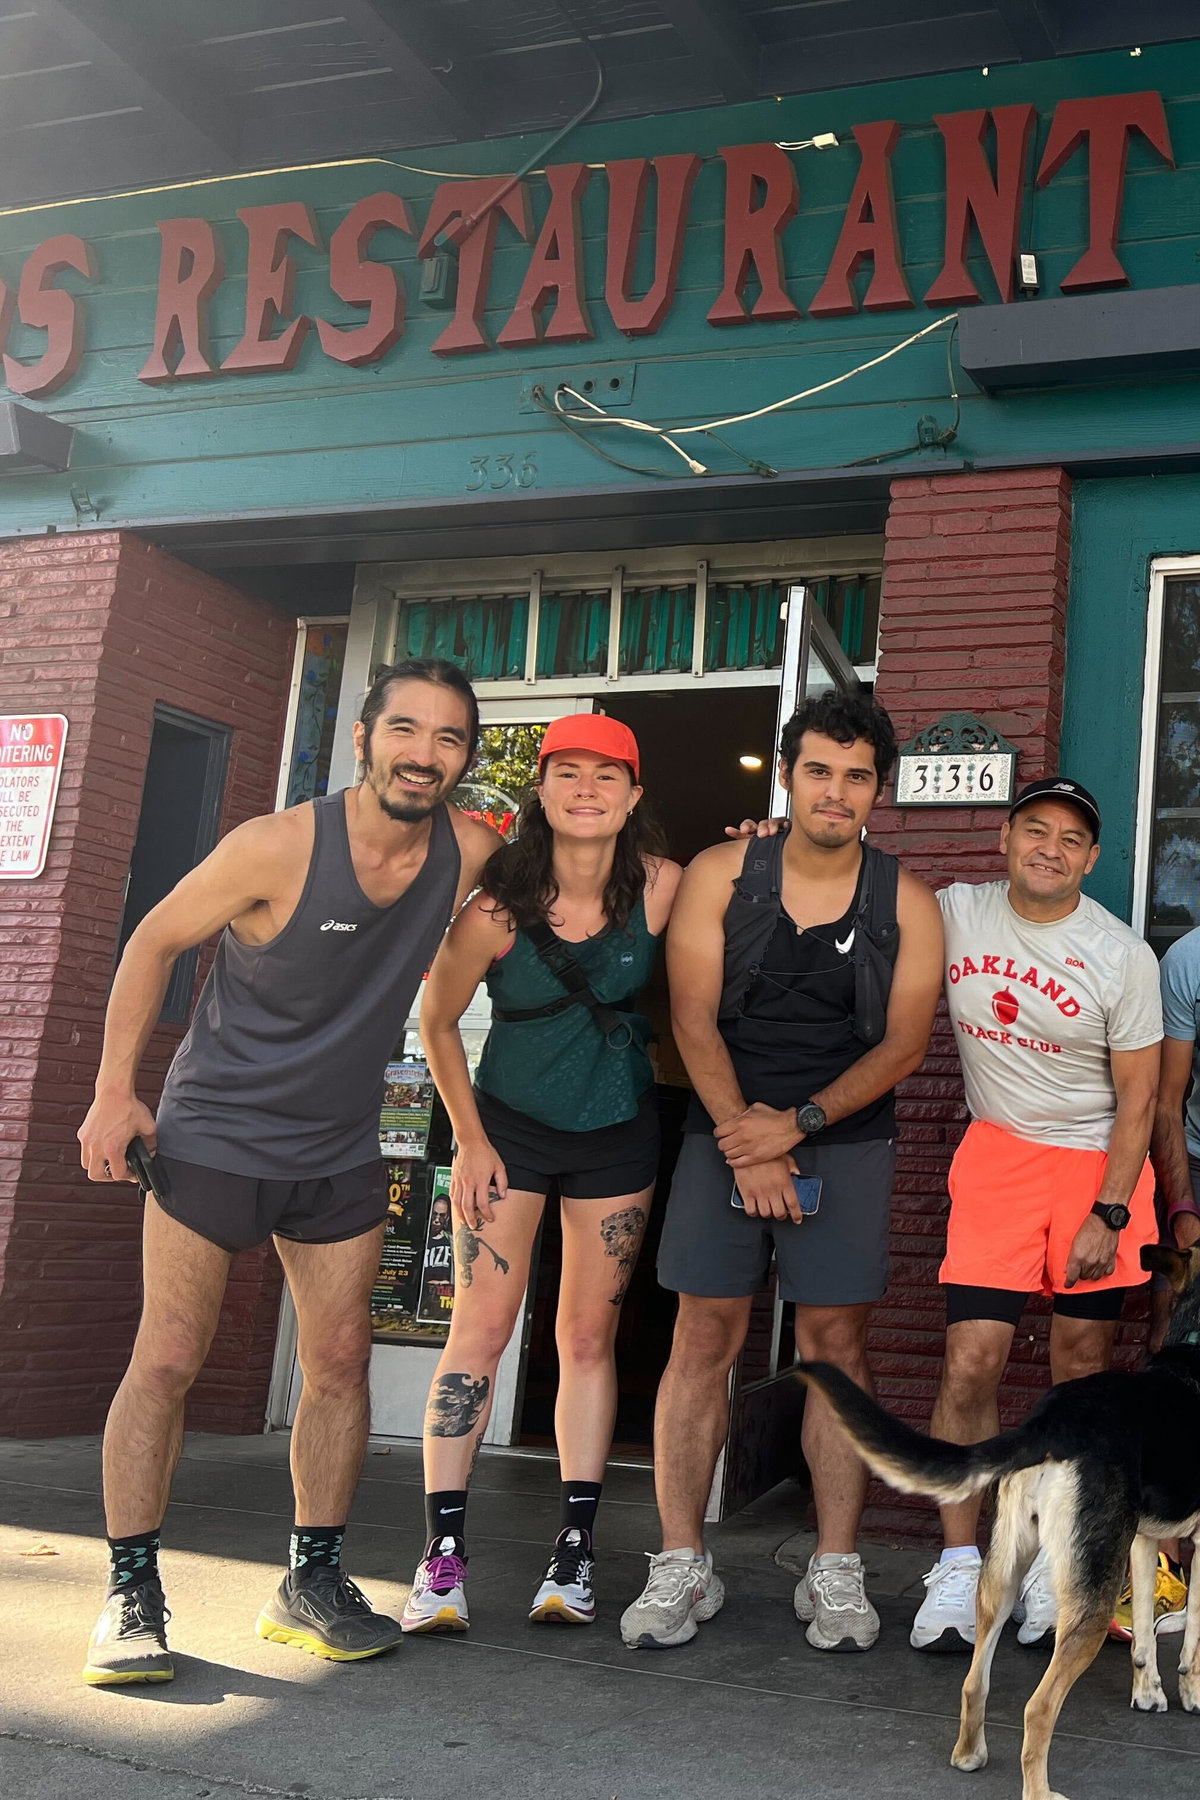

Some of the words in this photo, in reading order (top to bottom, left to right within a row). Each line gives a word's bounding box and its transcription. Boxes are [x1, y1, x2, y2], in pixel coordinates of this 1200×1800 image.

[0, 231, 96, 400] S
[137, 90, 1176, 386] RESTAURANT
[465, 450, 538, 491] 336
[10, 723, 34, 742] NO
[0, 744, 55, 763] ITERING
[912, 762, 994, 794] 336
[18, 790, 32, 802] BE
[6, 820, 25, 832] THE
[1, 835, 36, 847] EXTENT
[11, 850, 31, 862] LAW
[1064, 957, 1086, 970] BOA
[949, 954, 1081, 1018] OAKLAND
[957, 1020, 1014, 1045] TRACK
[1016, 1037, 1063, 1053] CLUB
